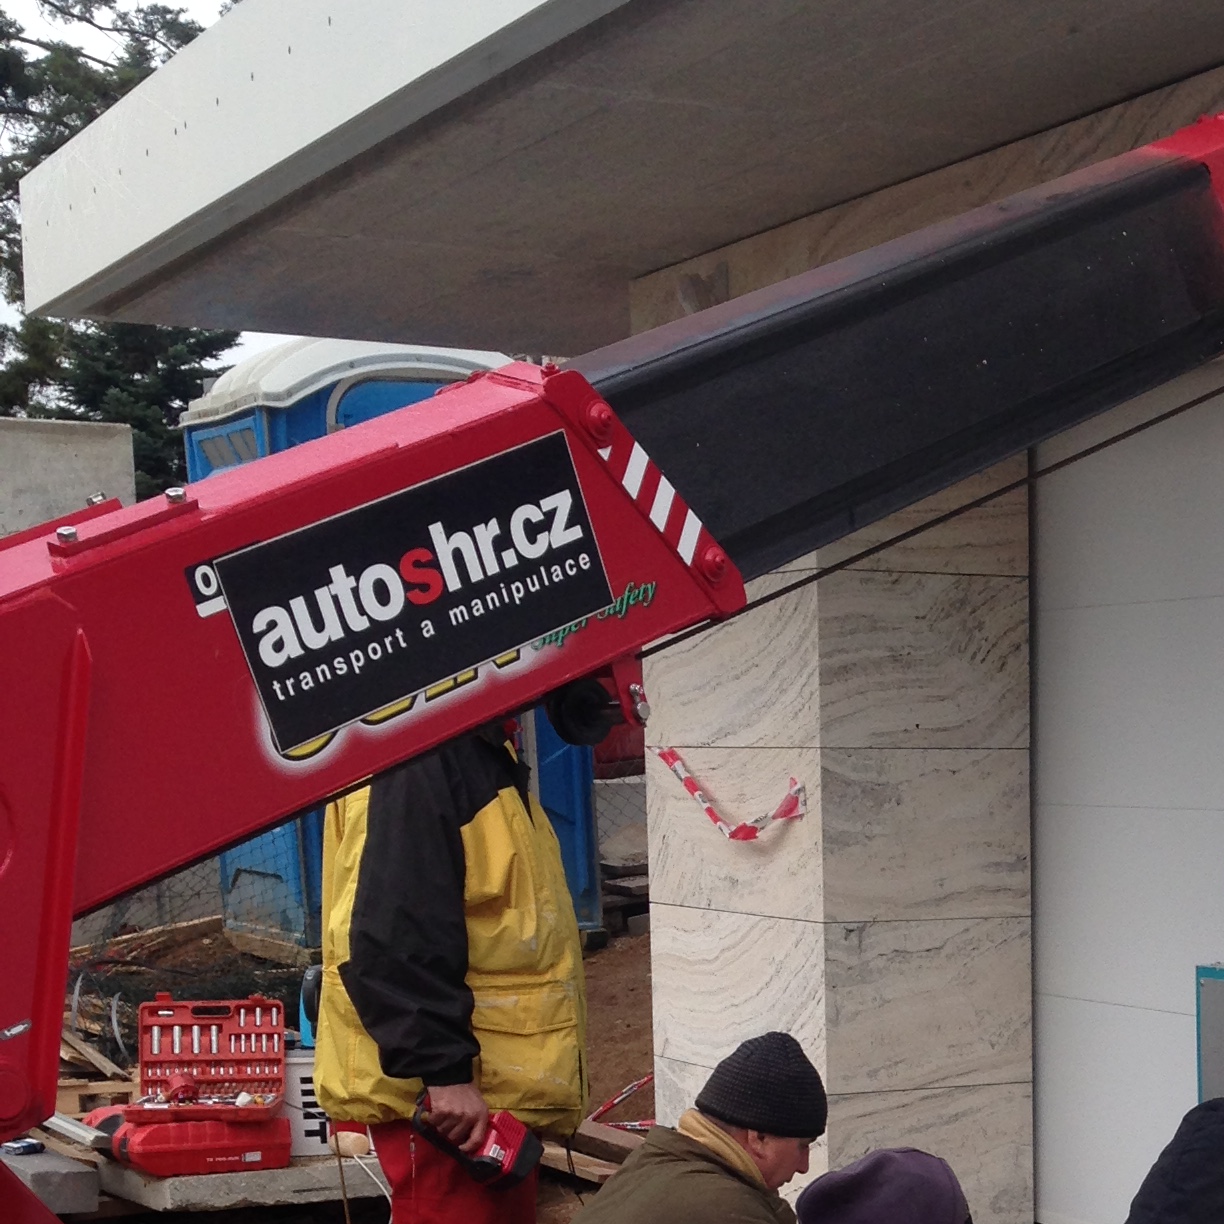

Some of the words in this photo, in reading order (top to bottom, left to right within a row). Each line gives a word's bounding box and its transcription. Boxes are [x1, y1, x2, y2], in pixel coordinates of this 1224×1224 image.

[252, 489, 584, 668] autoshr.cz
[272, 627, 407, 701] transport
[420, 617, 436, 638] a
[448, 550, 592, 626] manipulace
